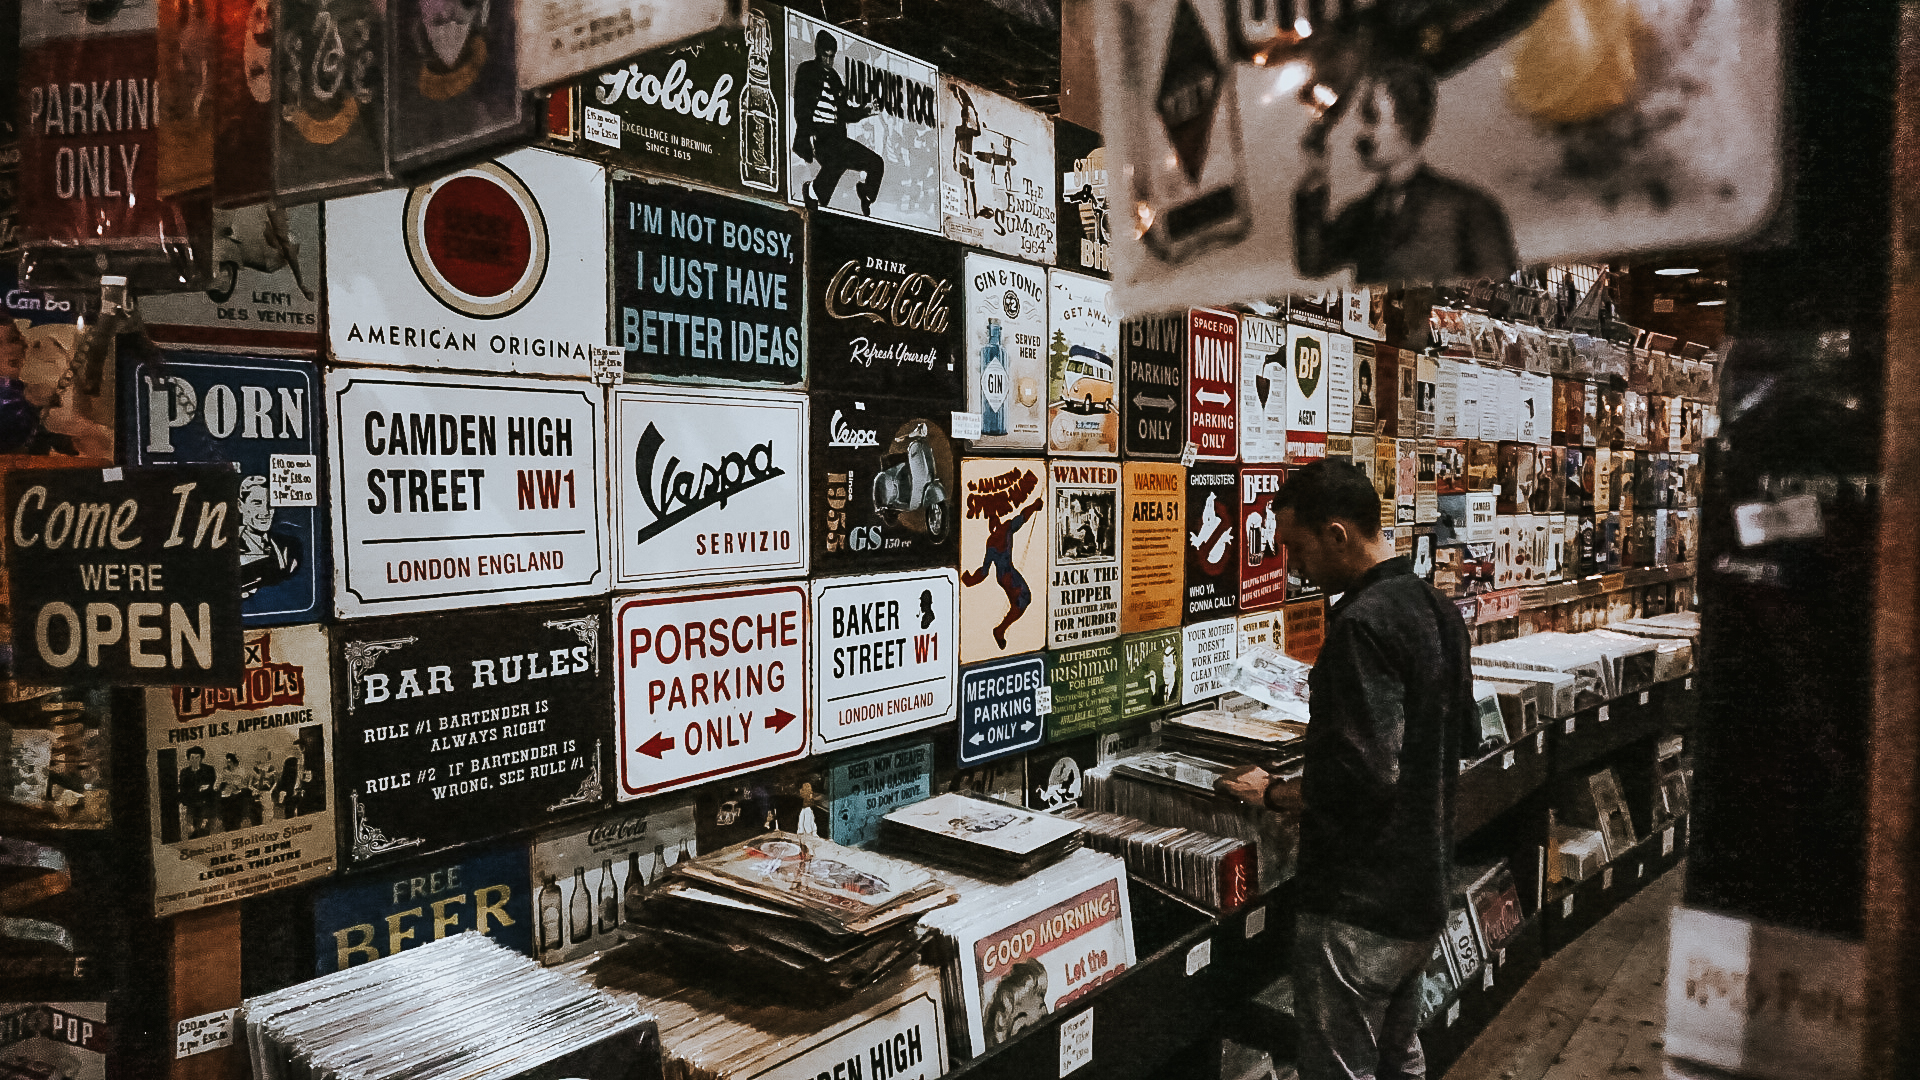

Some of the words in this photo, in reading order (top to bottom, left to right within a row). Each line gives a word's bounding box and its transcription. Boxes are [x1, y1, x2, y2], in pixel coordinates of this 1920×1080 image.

[621, 120, 668, 142] EXCELLENCE
[671, 134, 679, 145] IN
[681, 137, 713, 154] BREWING
[646, 142, 669, 156] SINCE
[673, 149, 691, 160] 1615
[56, 144, 140, 199] ONLY
[1023, 177, 1044, 203] THE
[1005, 192, 1056, 224] ENDLESS
[628, 201, 663, 236] I'M
[671, 212, 717, 245] NOT
[723, 221, 795, 265] BOSSY,
[994, 207, 1053, 245] SUMMER
[1021, 236, 1046, 254] 1964
[866, 256, 907, 275] DRINK
[636, 251, 644, 290] I
[653, 256, 718, 300] JUST
[726, 267, 788, 311] HAVE
[974, 271, 997, 293] GIN
[1000, 269, 1008, 285] &
[1010, 271, 1043, 303] TONIC
[217, 307, 249, 320] DES
[257, 310, 315, 325] VENTES
[1063, 307, 1083, 321] GET
[1087, 307, 1113, 328] AWAY
[1193, 317, 1218, 332] SPACE
[1219, 323, 1234, 335] FOR
[347, 323, 476, 353] AMERICAN
[622, 307, 723, 361] BETTER
[731, 321, 800, 368] IDEAS
[1015, 333, 1041, 348] SERVED
[1131, 315, 1178, 354] BMW
[1246, 319, 1285, 346] WINE
[849, 337, 894, 370] Refresh
[896, 343, 937, 370] Yourself
[1019, 348, 1037, 360] HERE
[1194, 334, 1233, 384] MINI
[1298, 346, 1320, 380] BP
[987, 372, 1003, 395] GIN
[1131, 361, 1179, 387] PARKING
[144, 375, 304, 453] PORN
[1138, 418, 1172, 440] ONLY
[1193, 411, 1234, 430] PARKING
[1298, 409, 1317, 426] AGENT
[363, 411, 496, 457] CAMDEN
[507, 415, 574, 458] HIGH
[828, 409, 880, 450] Vespa
[1201, 432, 1226, 448] ONLY
[636, 420, 786, 546] Vespa
[1053, 466, 1118, 485] WANTED
[1133, 473, 1178, 492] WARNING
[1190, 474, 1235, 486] GHOSTBUSTERS
[1243, 474, 1280, 504] BEER
[367, 468, 485, 515] STREET
[517, 468, 577, 510] NW1
[13, 485, 142, 550] Come
[163, 482, 228, 550] In
[1132, 502, 1163, 522] AREA
[1166, 501, 1179, 521] 51
[695, 530, 791, 556] SERVIZIO
[850, 525, 883, 551] GS
[884, 537, 900, 549] 150
[79, 563, 164, 592] WE'RE
[386, 556, 471, 584] LONDON
[478, 550, 565, 576] ENGLAND
[1052, 569, 1089, 587] JACK
[1093, 566, 1119, 583] THE
[1061, 585, 1112, 605] RIPPER
[1190, 584, 1205, 598] WHO
[1206, 583, 1215, 595] YA
[1190, 598, 1214, 613] GONNA
[1214, 594, 1236, 609] CALL?
[832, 599, 900, 639] BAKER
[1054, 607, 1071, 618] ALIAS
[1072, 603, 1098, 616] LEATHER
[1099, 601, 1118, 612] APRON
[1055, 617, 1075, 632] FOR
[1077, 611, 1117, 629] MURDER
[35, 601, 213, 670] OPEN
[629, 609, 799, 670] PORSCHE
[1055, 631, 1079, 643] £150
[1081, 625, 1117, 639] REWARD
[1188, 628, 1207, 642] YOUR
[1208, 623, 1235, 638] MOTHER
[1198, 637, 1226, 654] DOESN'T
[833, 637, 907, 679] STREET
[913, 632, 938, 665] W1
[1059, 646, 1113, 664] AUTHENTIC
[1191, 655, 1212, 668] WORK
[1213, 650, 1231, 664] HERE
[364, 664, 455, 705] BAR
[472, 645, 589, 690] RULES
[648, 660, 786, 715] PARKING
[967, 669, 1040, 703] MERCEDES
[1069, 679, 1086, 690] FOR
[1087, 675, 1105, 687] HIRE
[1190, 667, 1213, 682] CLEAN
[1194, 683, 1209, 695] OWN
[364, 722, 409, 744] RULE
[415, 719, 433, 735] #1
[438, 703, 530, 731] BARTENDER
[535, 699, 549, 714] IS
[838, 701, 884, 726] LONDON
[887, 691, 934, 716] ENGLAND
[974, 696, 1032, 725] PARKING
[168, 725, 205, 743] FIRST
[208, 721, 233, 738] U.S.
[236, 709, 314, 734] APPEARANCE
[430, 726, 498, 752] ALWAYS
[502, 718, 546, 739] RIGHT
[683, 709, 754, 756] ONLY
[987, 721, 1017, 744] ONLY
[365, 773, 411, 794] RULE
[416, 767, 437, 784] #2
[448, 761, 466, 777] IF
[470, 743, 558, 774] BARTENDER
[562, 739, 576, 754] IS
[499, 768, 528, 786] SEE
[530, 760, 567, 779] RULE
[570, 755, 586, 770] #1
[864, 779, 886, 796] THAN
[866, 798, 877, 810] SO
[878, 790, 899, 807] DON'T
[901, 784, 921, 800] DRIVE
[179, 840, 227, 861] Special
[231, 832, 280, 851] Holiday
[282, 824, 313, 839] Show
[199, 864, 245, 881] LEONA
[248, 850, 302, 870] THEATRE
[210, 853, 242, 867] DEC.
[393, 863, 464, 906] FREE
[332, 883, 516, 972] BEER
[982, 928, 1036, 974] GOOD
[1039, 889, 1117, 946] MORNING!
[1065, 956, 1087, 986] Let
[1087, 949, 1109, 974] the
[53, 1012, 94, 1046] POP
[869, 1024, 923, 1080] HIGH
